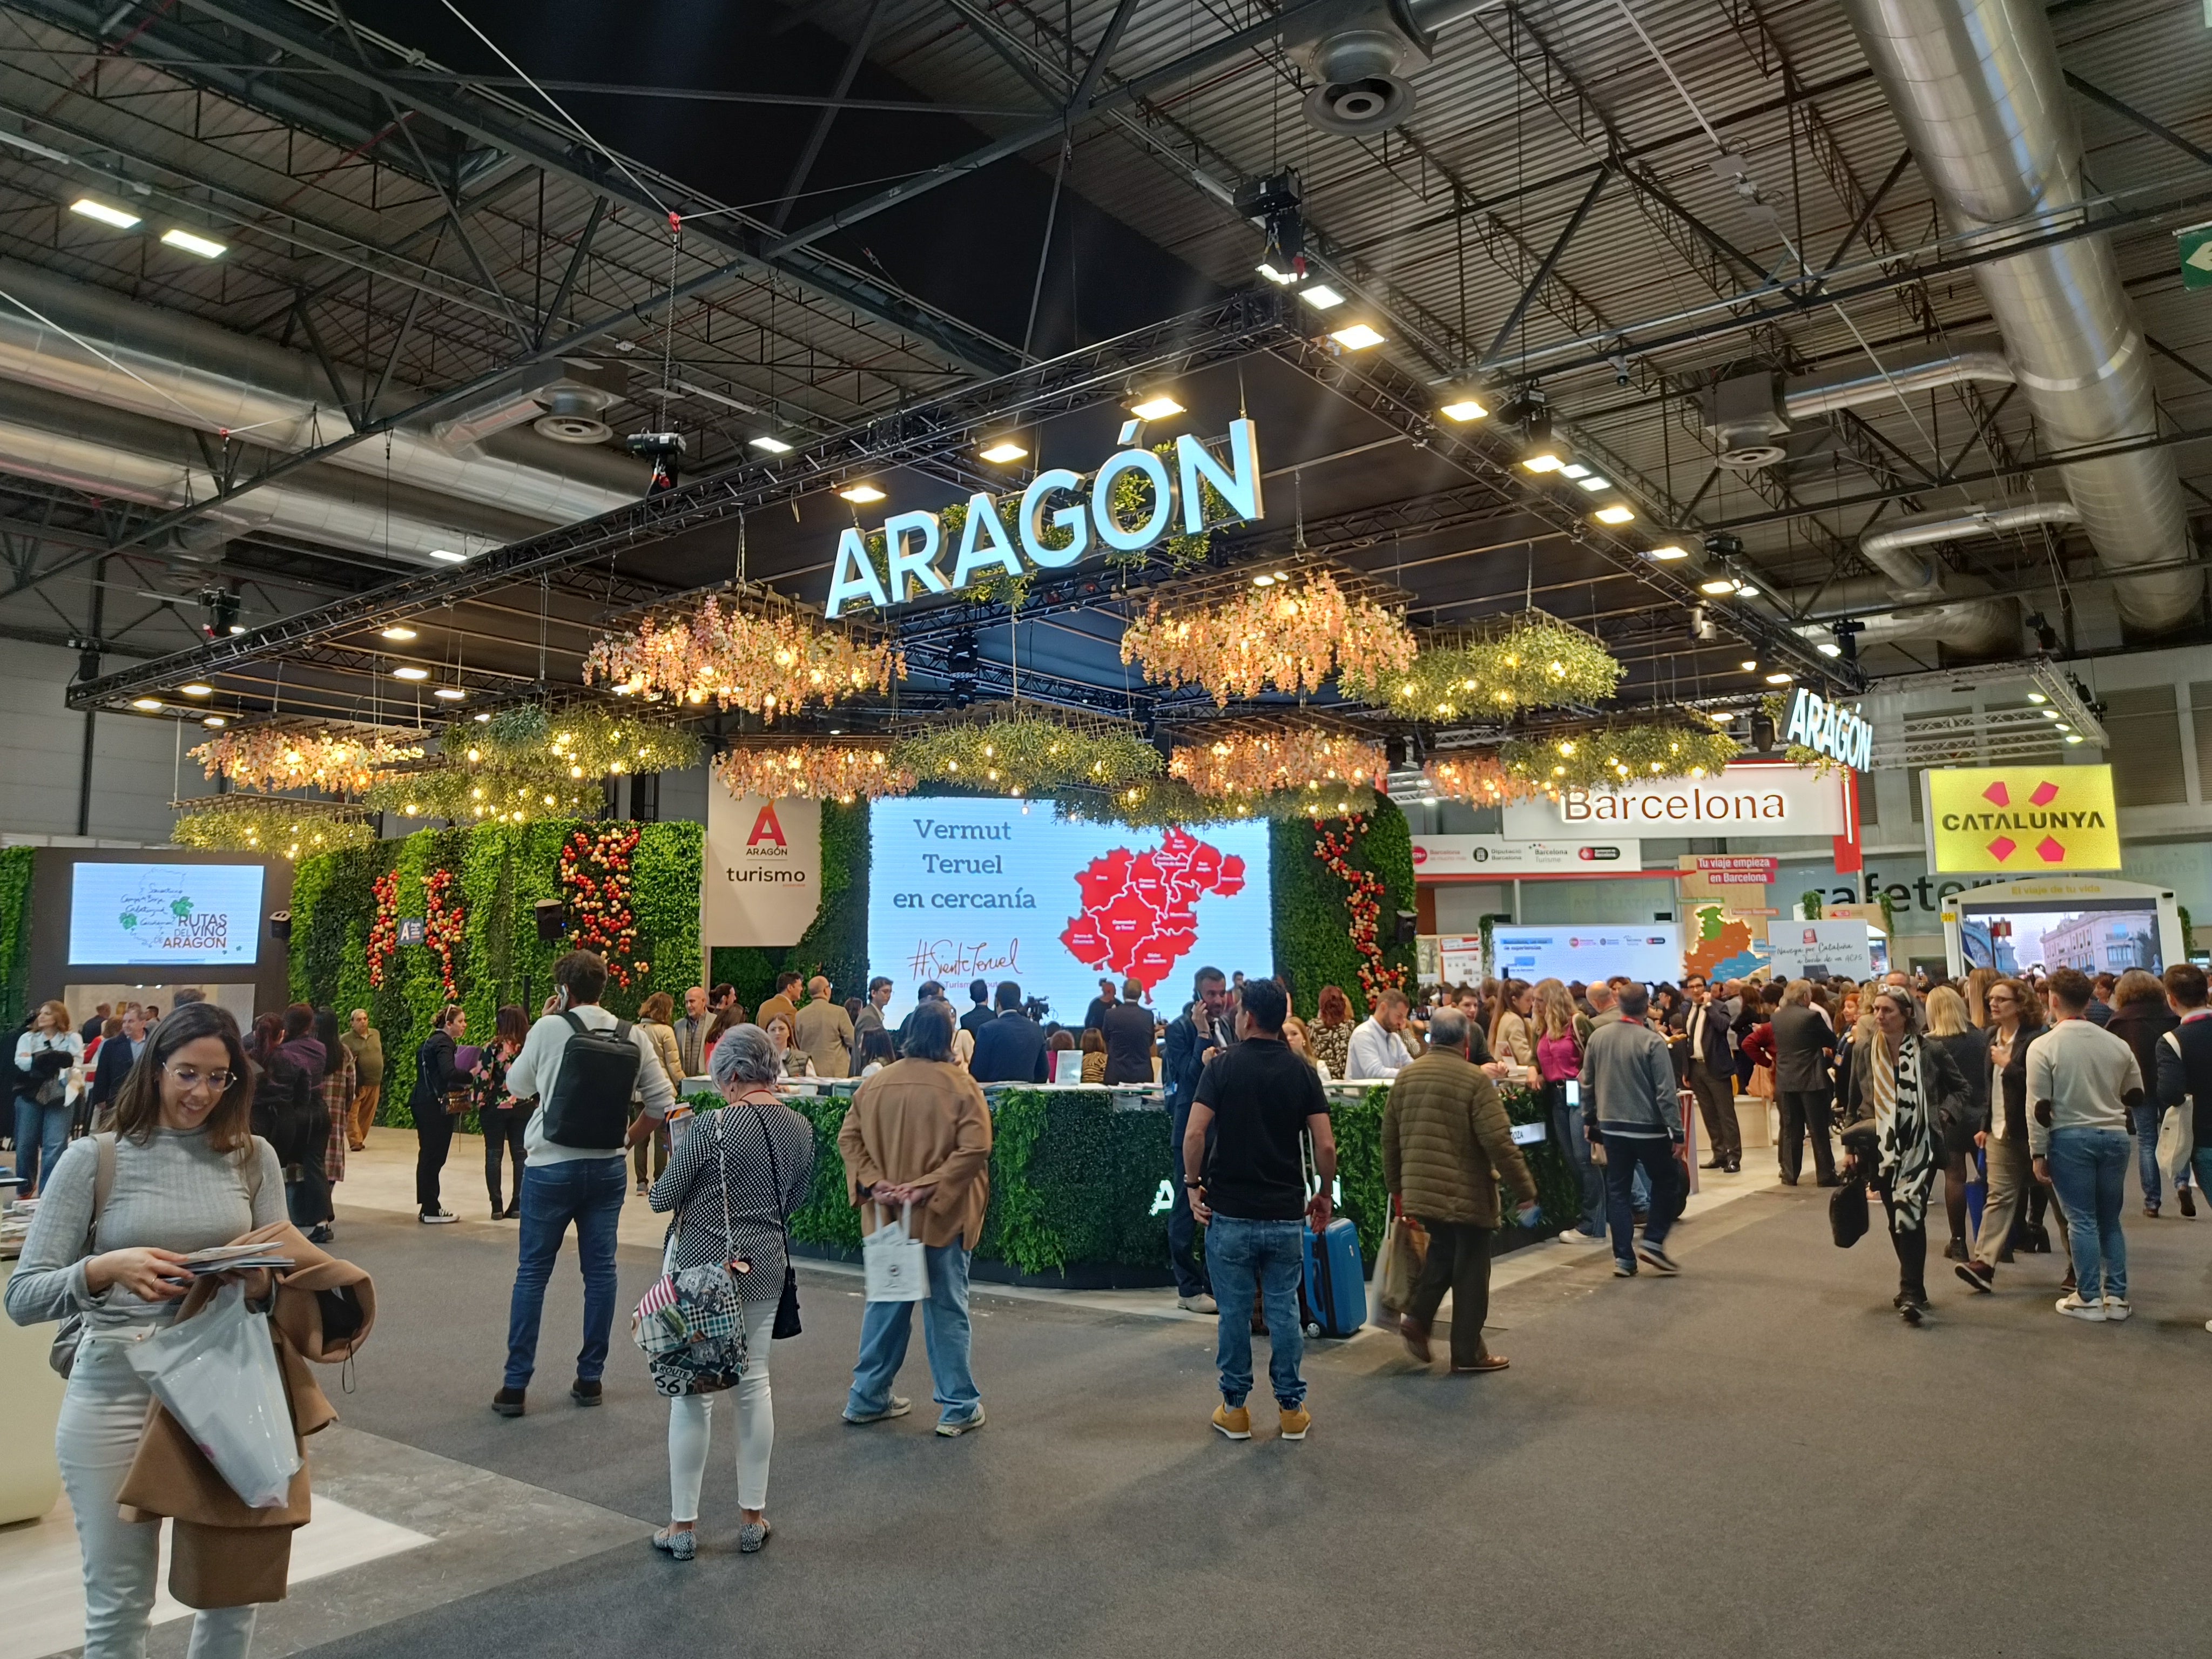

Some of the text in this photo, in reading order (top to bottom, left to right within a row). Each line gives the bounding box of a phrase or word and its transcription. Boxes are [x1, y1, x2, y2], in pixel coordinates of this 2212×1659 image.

[825, 419, 1264, 619] ARAGÓN
[1788, 687, 1872, 773] ARAGÓN
[1566, 788, 1784, 820] Barcelona
[1942, 811, 2105, 831] CATALUNYA
[913, 819, 1011, 840] Vermut
[746, 846, 787, 855] ARAGÓN
[922, 853, 1003, 874] Teruel
[1698, 858, 1770, 869] Tu viaje empieza
[726, 866, 805, 882] turismo
[1723, 873, 1767, 882] Barcelona
[2011, 884, 2101, 895] El viaje de tu vida
[893, 887, 1036, 908] en cercanía
[178, 914, 227, 927] RUTAS
[174, 925, 227, 938] DEL VINO
[163, 936, 227, 948] ARAGÓN
[1818, 942, 1852, 953] Cataluña
[907, 938, 1023, 981] #SienteTeruel
[1513, 1130, 1523, 1139] OZA
[659, 1365, 690, 1379] ROUTE
[655, 1374, 680, 1394] 66
